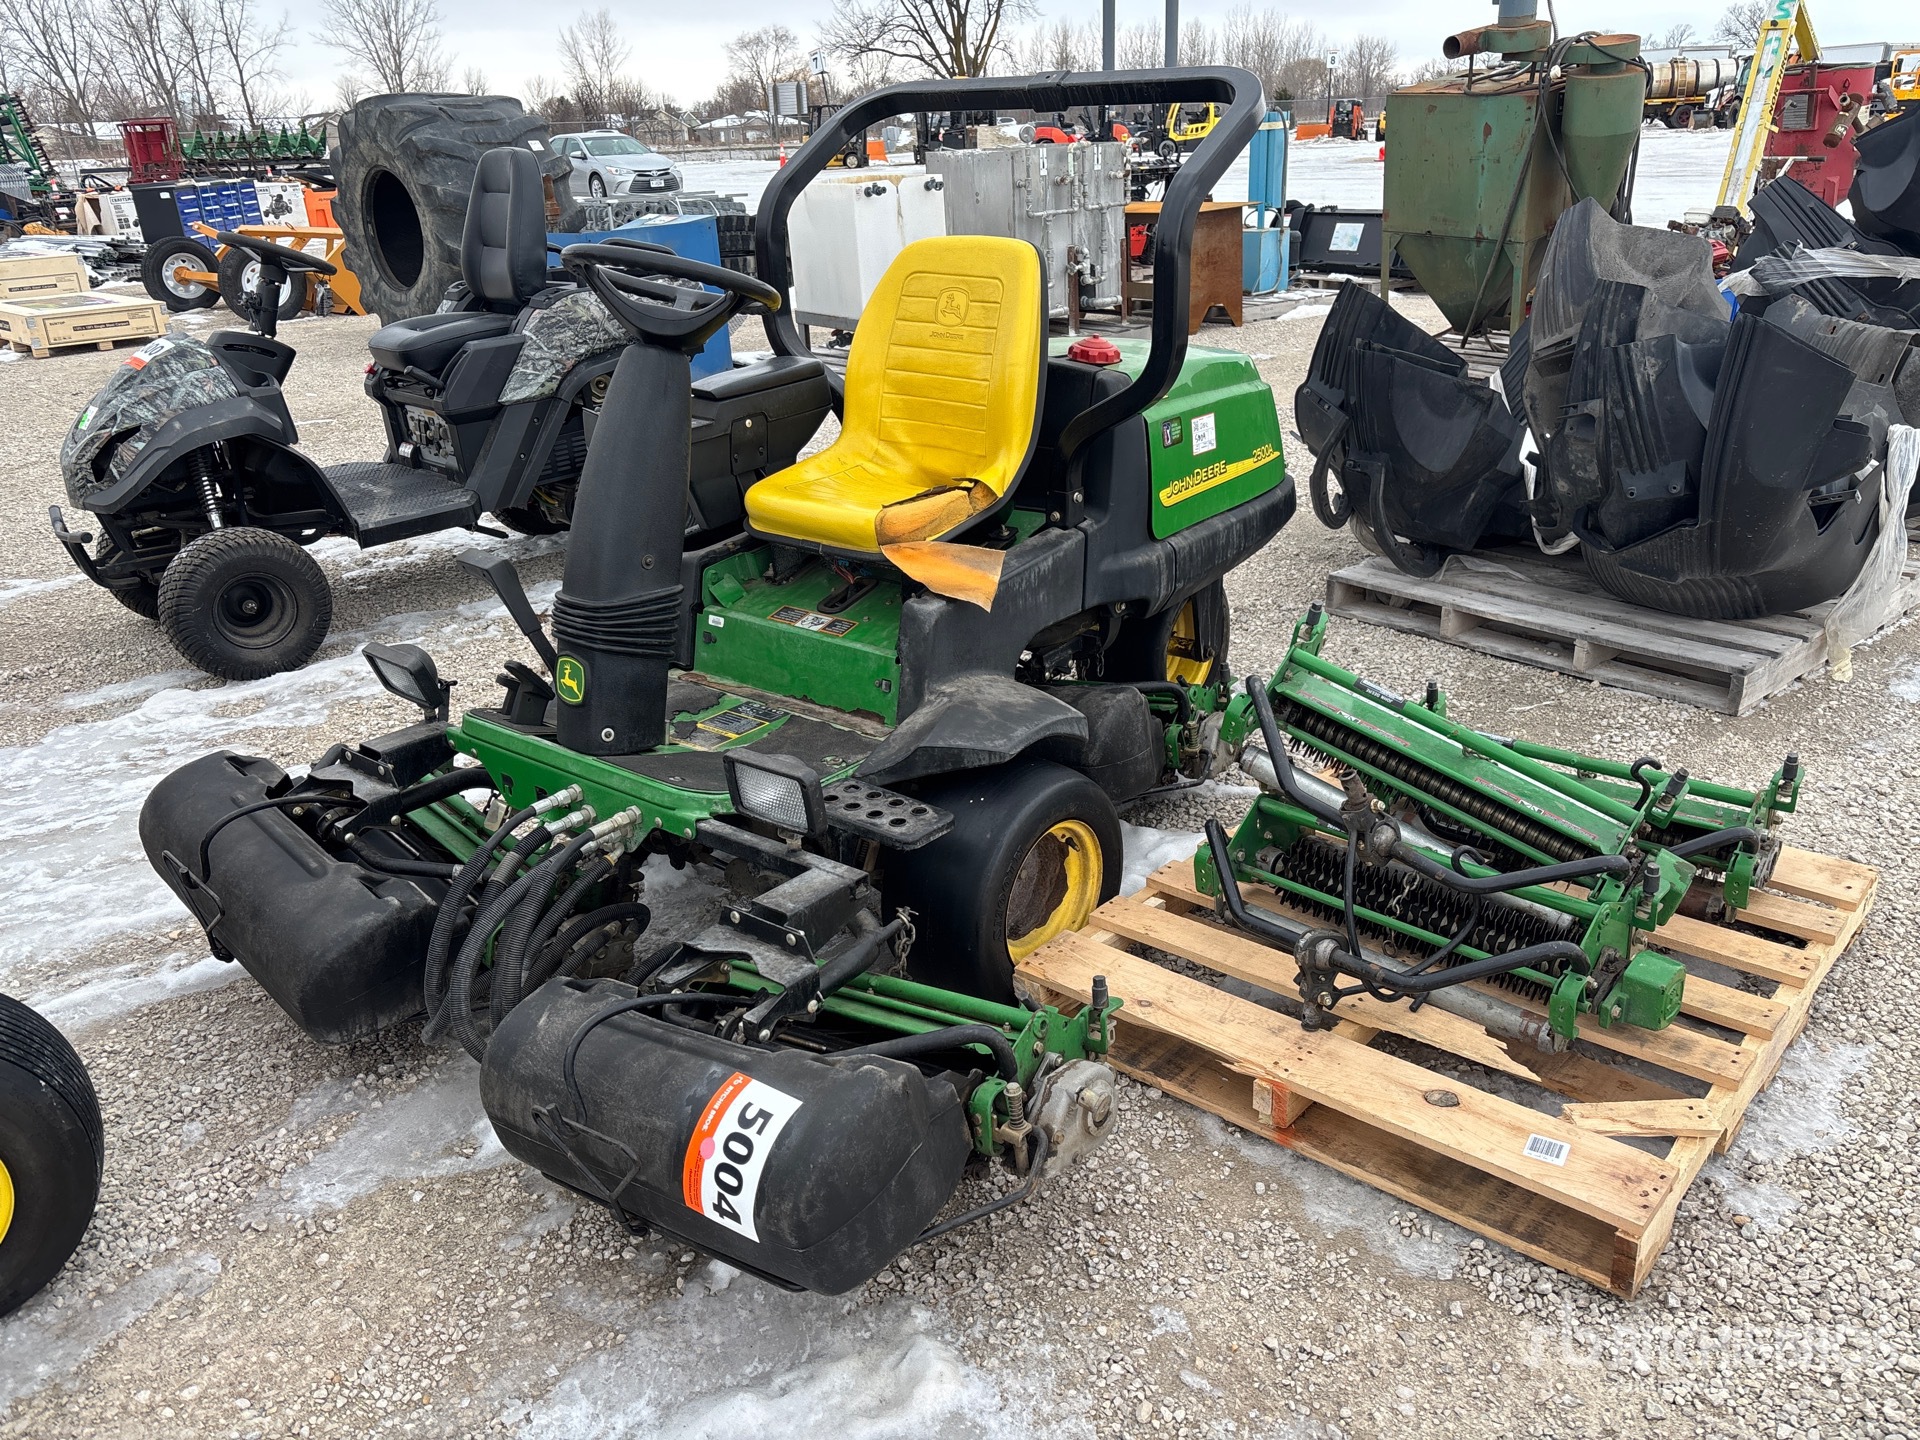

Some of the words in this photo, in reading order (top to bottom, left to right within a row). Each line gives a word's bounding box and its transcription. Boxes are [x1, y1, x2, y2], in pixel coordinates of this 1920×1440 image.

[812, 56, 818, 69] 7
[1330, 55, 1336, 65] 8
[1769, 34, 1794, 116] NORTHROCK
[1252, 443, 1275, 463] 2500A
[1166, 475, 1194, 498] JOHN
[1193, 460, 1228, 486] DEERE
[714, 1085, 735, 1112] RITCHIE
[712, 1101, 774, 1225] 5004
